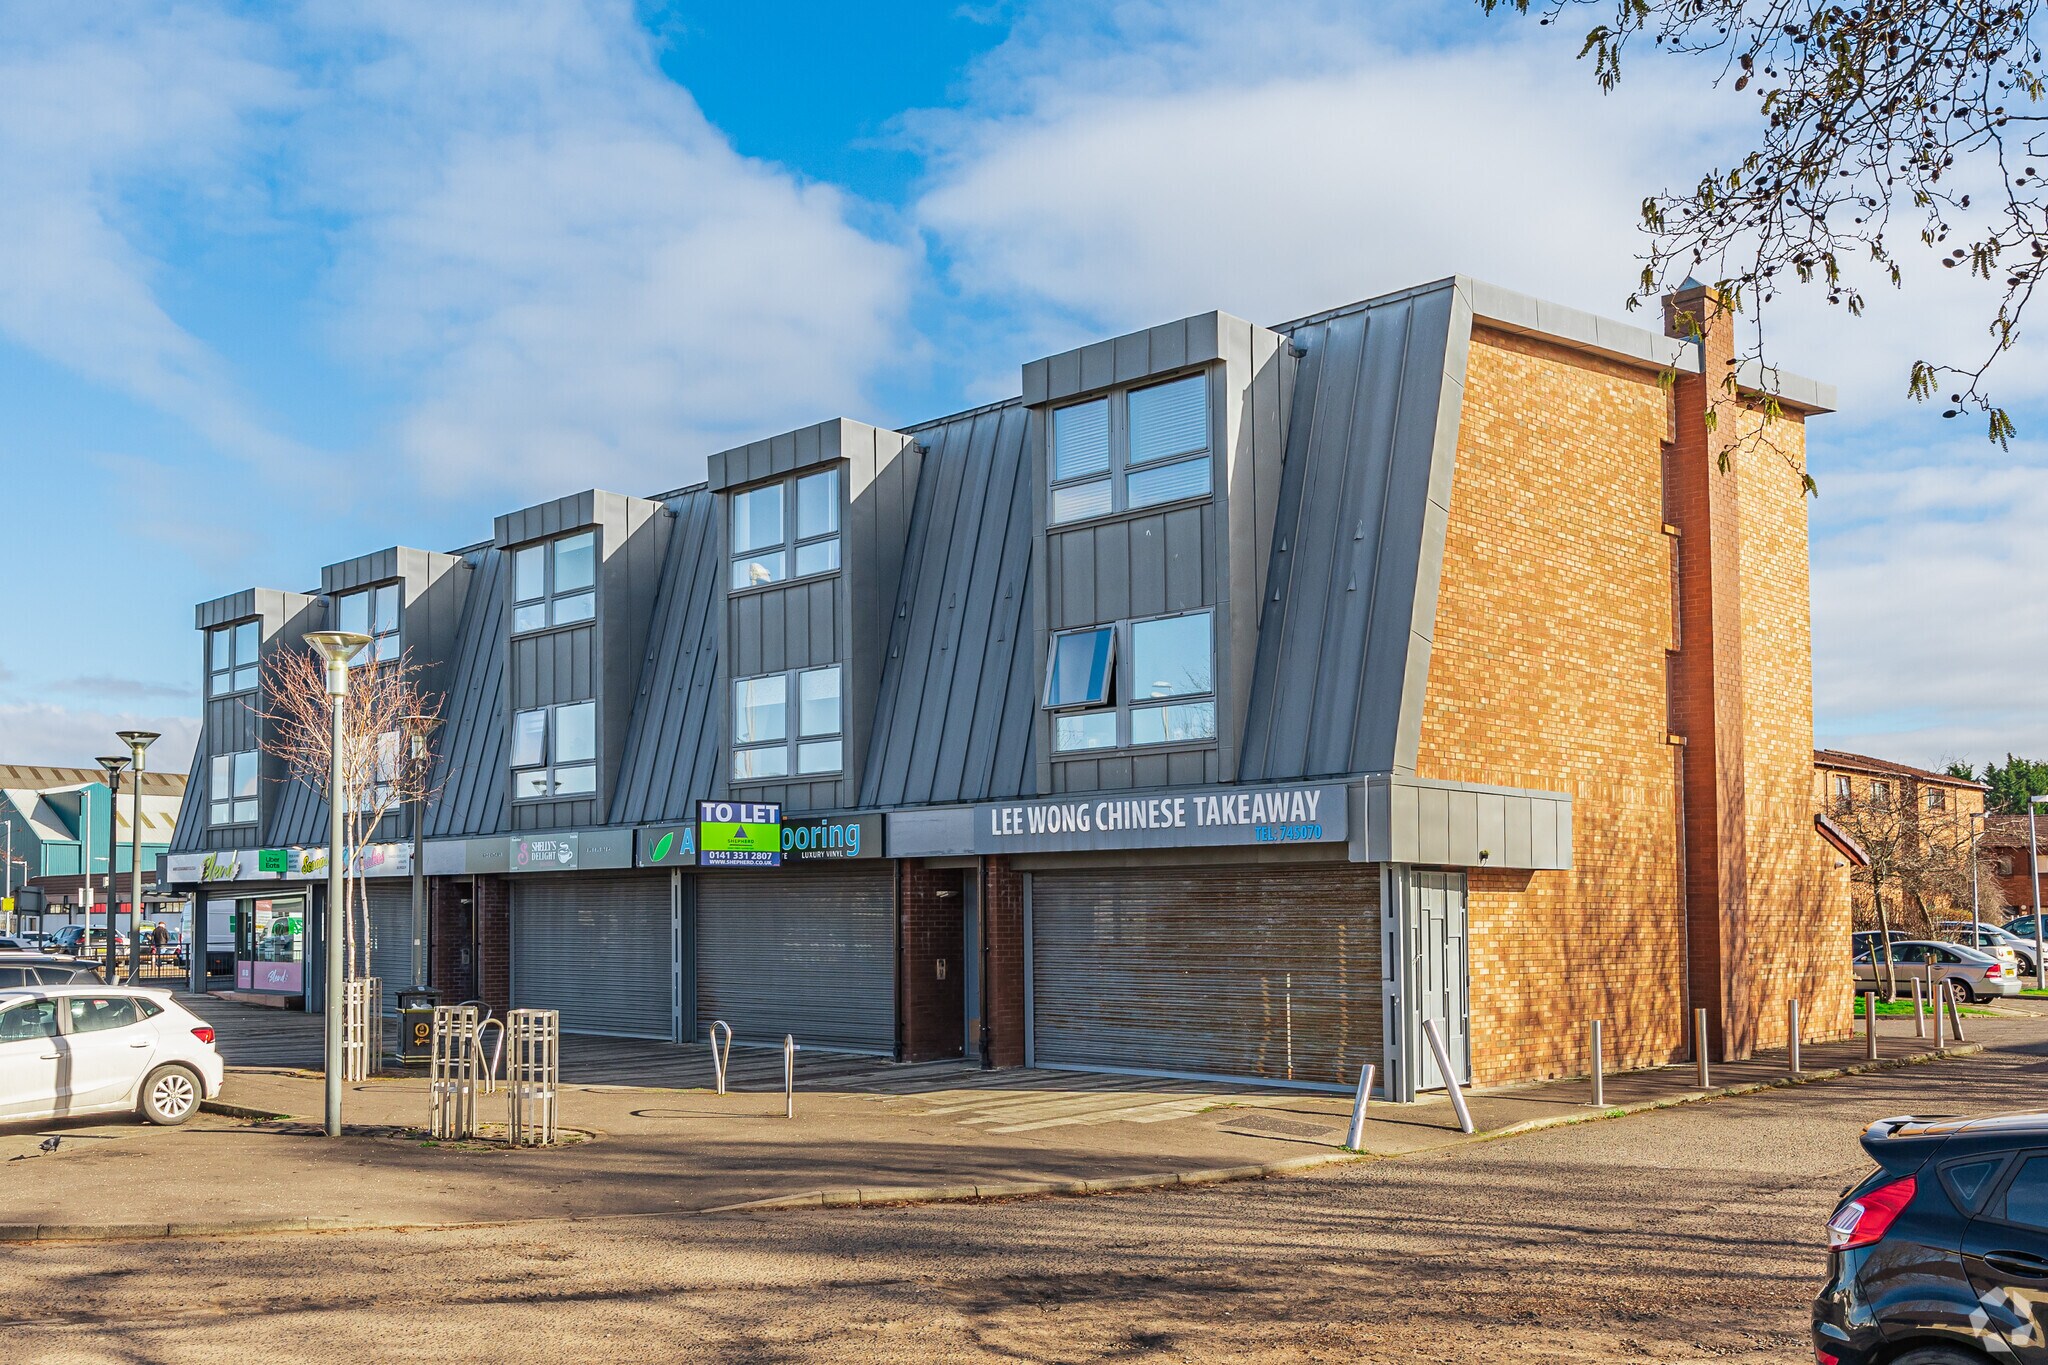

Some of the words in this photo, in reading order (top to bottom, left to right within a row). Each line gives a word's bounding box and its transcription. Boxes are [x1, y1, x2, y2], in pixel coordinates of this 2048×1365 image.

[702, 802, 733, 822] TO
[740, 804, 779, 824] LET
[991, 806, 1024, 836] LEE
[1027, 803, 1091, 835] WONG
[1095, 797, 1187, 832] CHINESE
[1192, 790, 1322, 827] TAKEAWAY
[782, 818, 861, 857] ooring
[1255, 825, 1278, 841] TEL:
[1279, 823, 1322, 840] 745070
[531, 840, 557, 852] SHELLY'S
[531, 851, 556, 861] DELIGHT
[709, 851, 730, 859] 0141
[733, 851, 749, 860] 331
[751, 852, 772, 860] 2807
[801, 850, 825, 859] LUXURY
[825, 850, 844, 858] VINYL
